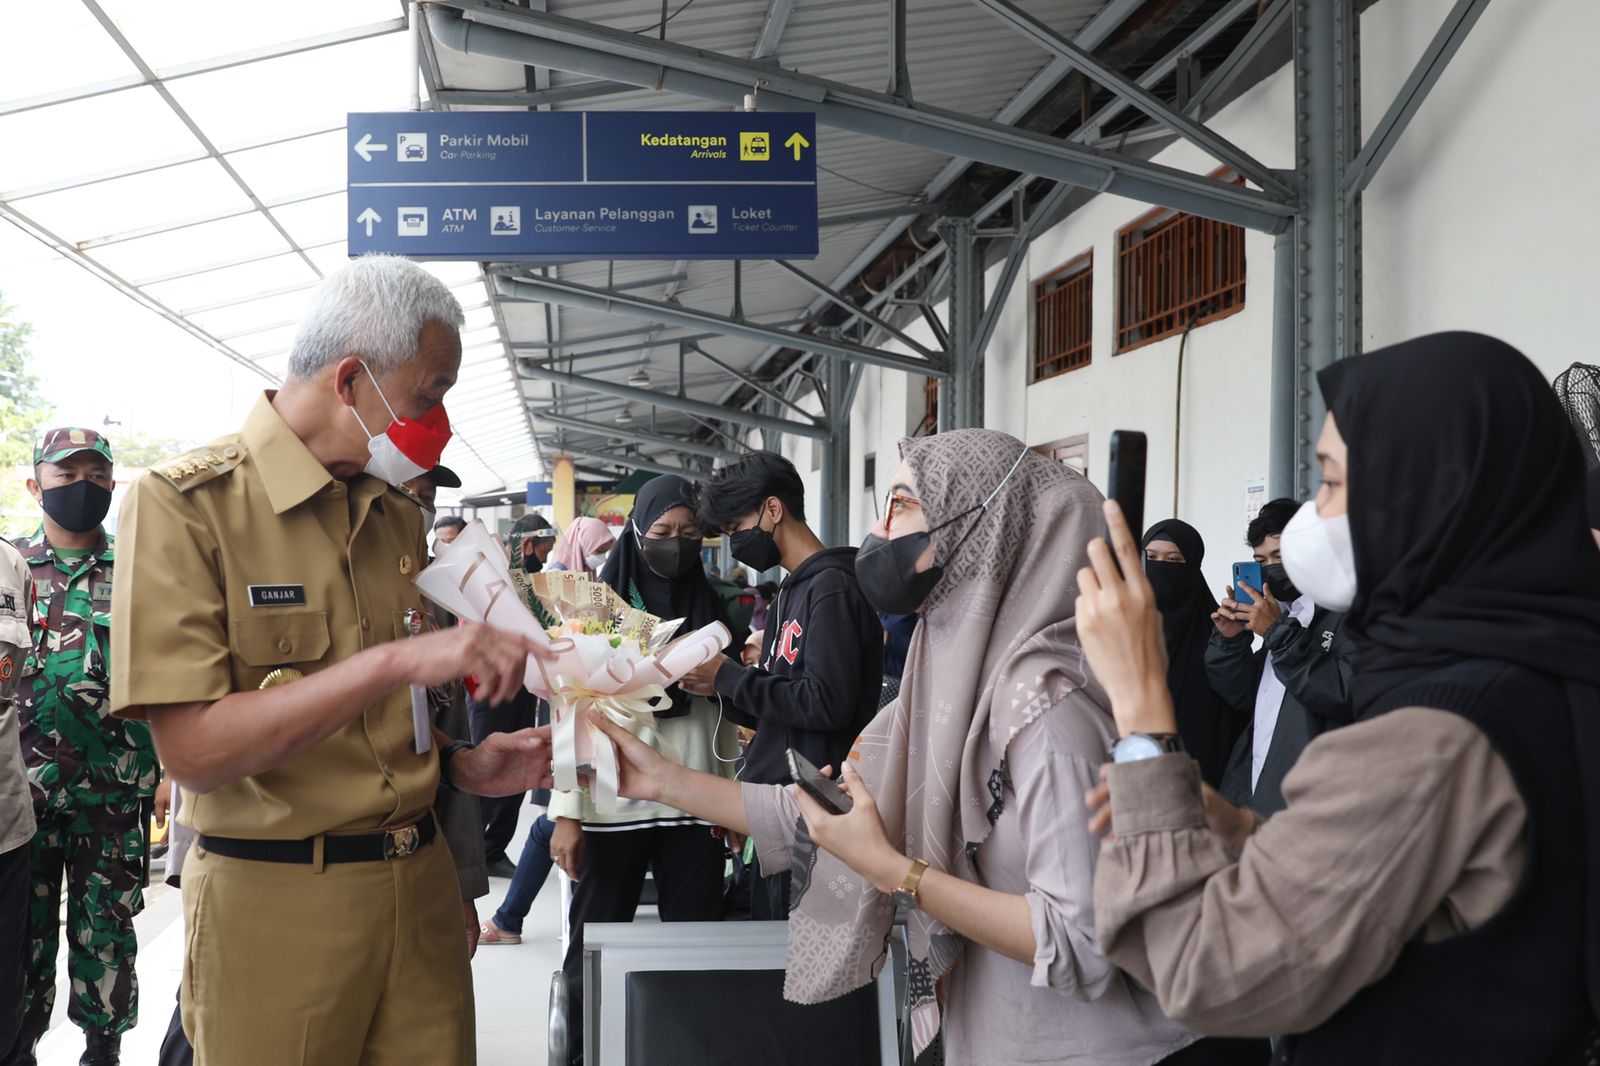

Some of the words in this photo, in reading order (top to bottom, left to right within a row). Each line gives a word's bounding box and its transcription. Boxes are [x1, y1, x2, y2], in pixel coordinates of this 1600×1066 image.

[440, 134, 482, 146] Parkir
[487, 134, 529, 146] Mobil
[641, 133, 727, 149] Kedatangan
[440, 150, 458, 160] Car
[461, 150, 497, 161] Parking
[690, 150, 727, 159] Arrivals
[442, 208, 477, 221] ATM
[535, 208, 596, 222] Layanan
[599, 207, 674, 222] Pelanggan
[732, 207, 772, 219] Loket
[441, 224, 464, 233] ATM
[534, 223, 580, 233] Customer
[582, 223, 617, 233] Service
[732, 223, 759, 232] Ticket
[761, 222, 799, 232] Counter
[261, 590, 296, 601] GANJAR
[593, 585, 603, 608] 5000
